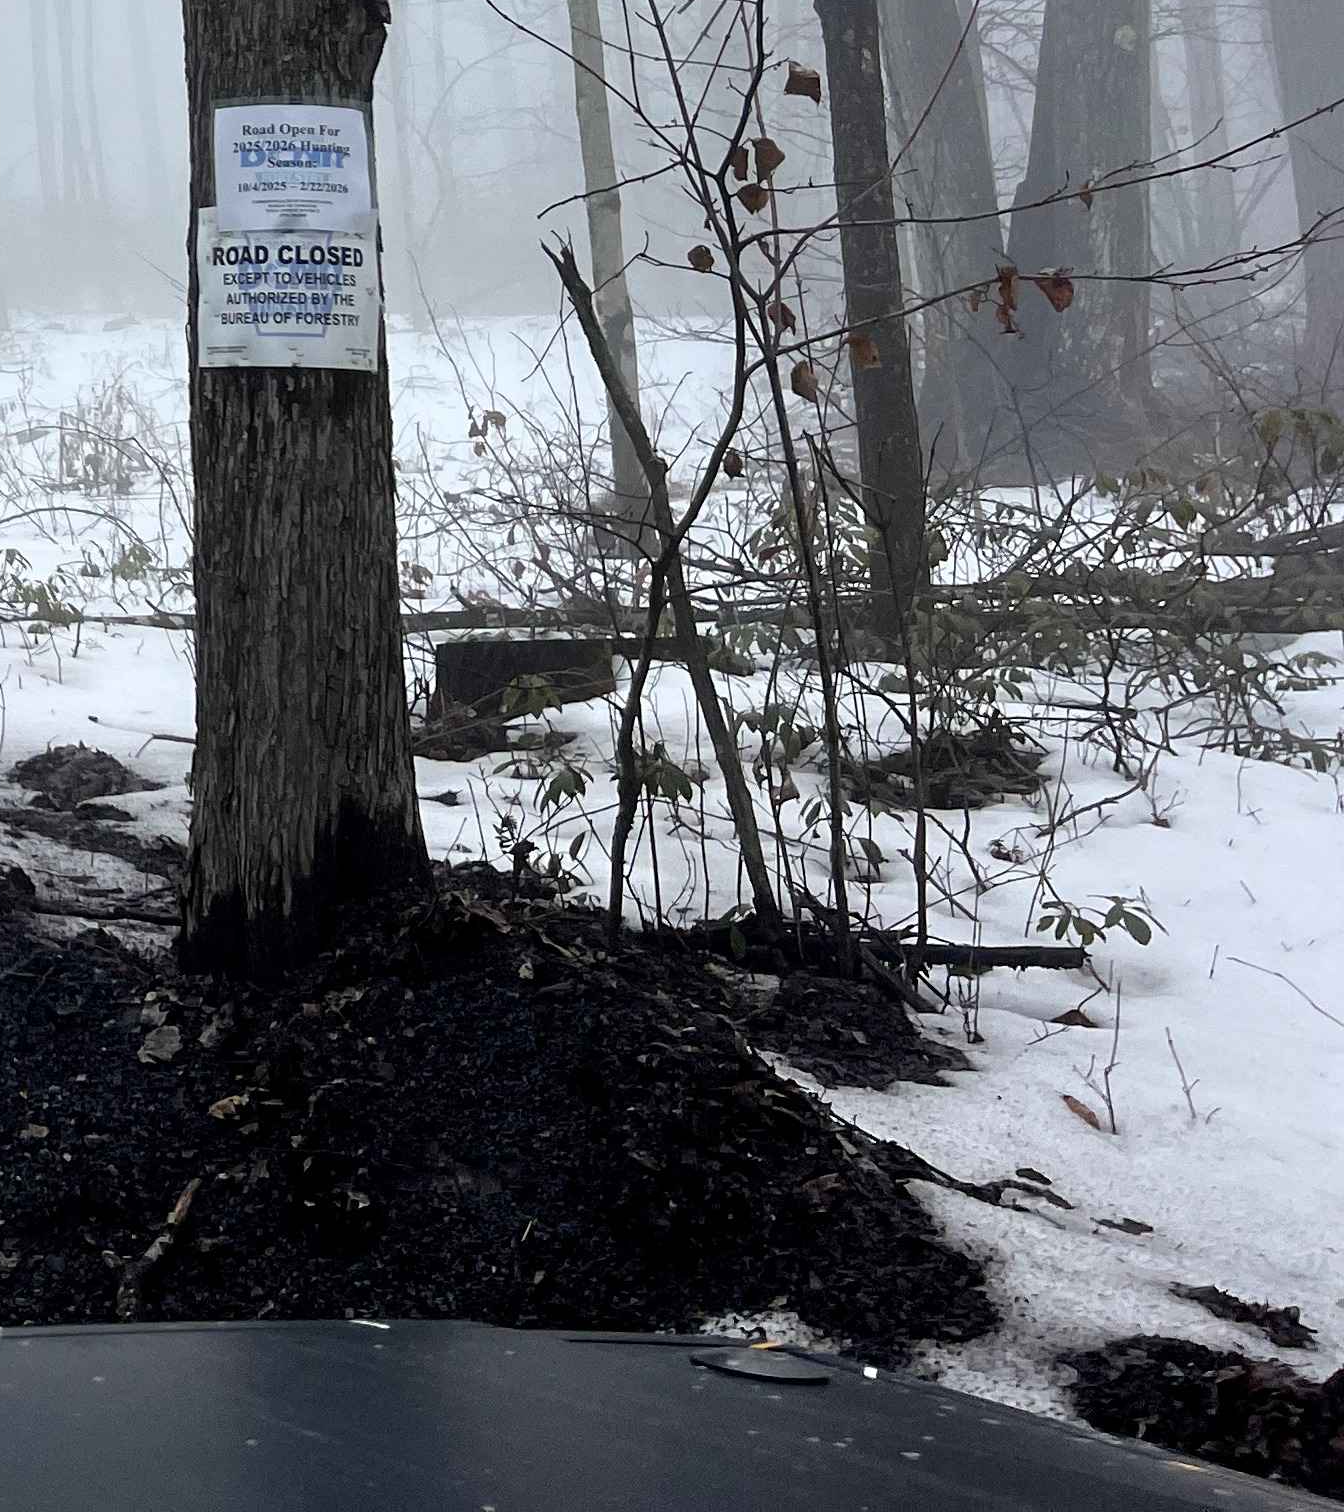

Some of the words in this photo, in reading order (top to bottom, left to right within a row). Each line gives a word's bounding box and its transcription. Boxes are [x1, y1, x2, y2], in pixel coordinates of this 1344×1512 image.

[242, 123, 275, 136] Road
[279, 123, 314, 137] Open
[319, 125, 340, 136] For
[301, 141, 350, 157] Hunting
[267, 156, 317, 169] Season:
[213, 245, 269, 266] ROAD
[278, 245, 363, 267] CLOSED
[224, 272, 269, 286] EXCEPT
[275, 272, 291, 285] TO
[296, 273, 356, 287] VEHICLES
[226, 292, 307, 306] AUTHORIZED
[312, 293, 328, 305] BY
[334, 294, 354, 306] THE
[221, 312, 269, 325] BUREAU
[273, 312, 291, 324] OF
[296, 312, 360, 327] FORESTRY
